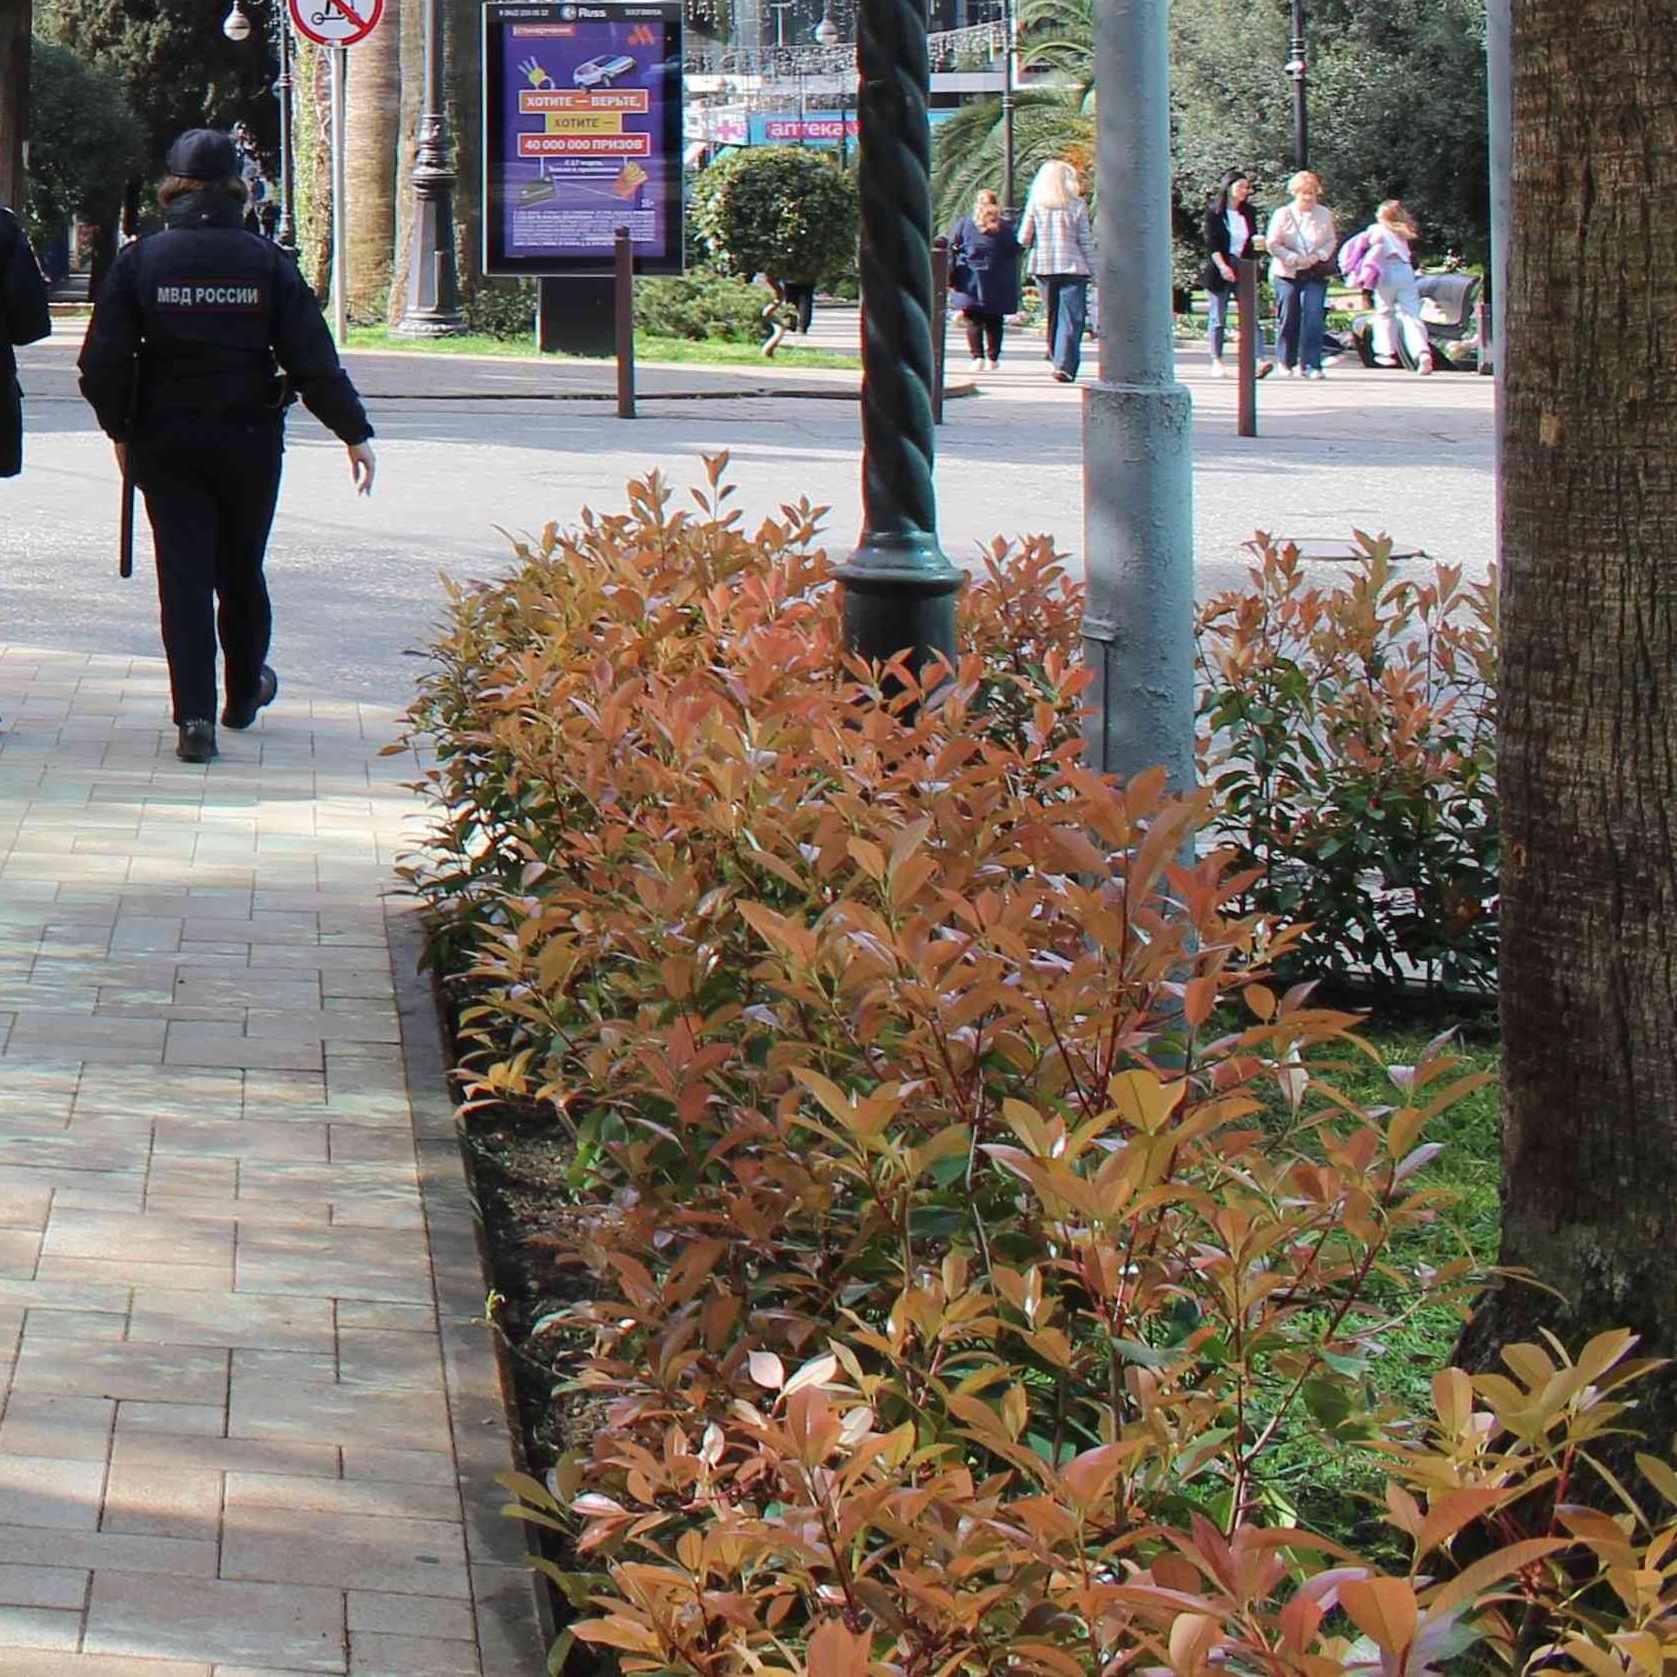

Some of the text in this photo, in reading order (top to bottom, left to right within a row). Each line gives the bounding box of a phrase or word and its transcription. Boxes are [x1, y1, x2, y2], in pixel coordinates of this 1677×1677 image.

[577, 7, 607, 18] Russ
[527, 96, 573, 107] ХОТИТЕ
[555, 118, 598, 128] ХОТИТЕ
[157, 287, 258, 306] МВД РОССИИ
